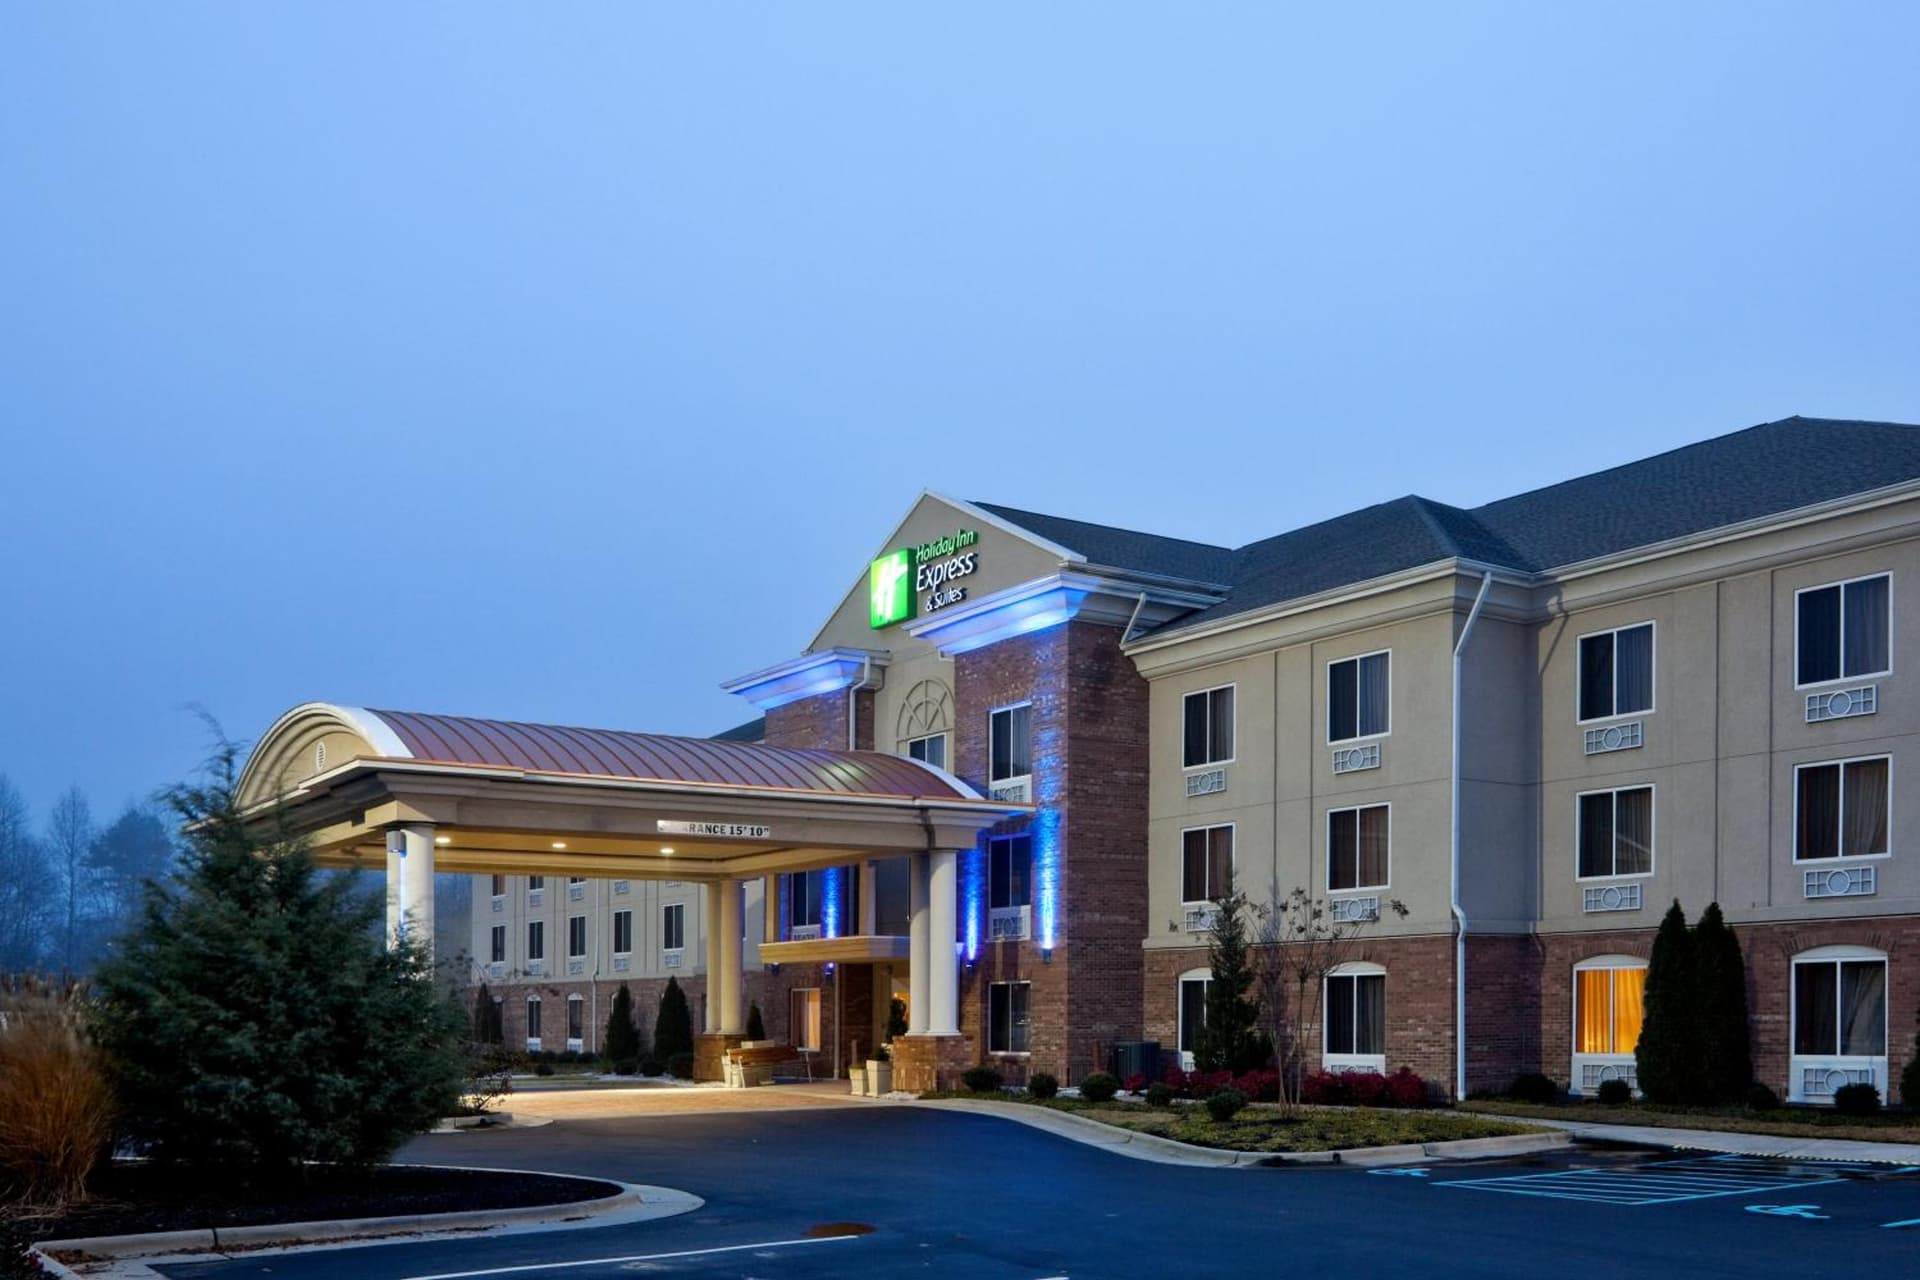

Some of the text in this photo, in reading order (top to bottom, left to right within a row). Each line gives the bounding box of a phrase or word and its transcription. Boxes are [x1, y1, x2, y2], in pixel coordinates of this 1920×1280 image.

[916, 529, 976, 563] Holiday Inn
[916, 552, 975, 592] Express
[925, 587, 963, 612] & Suites
